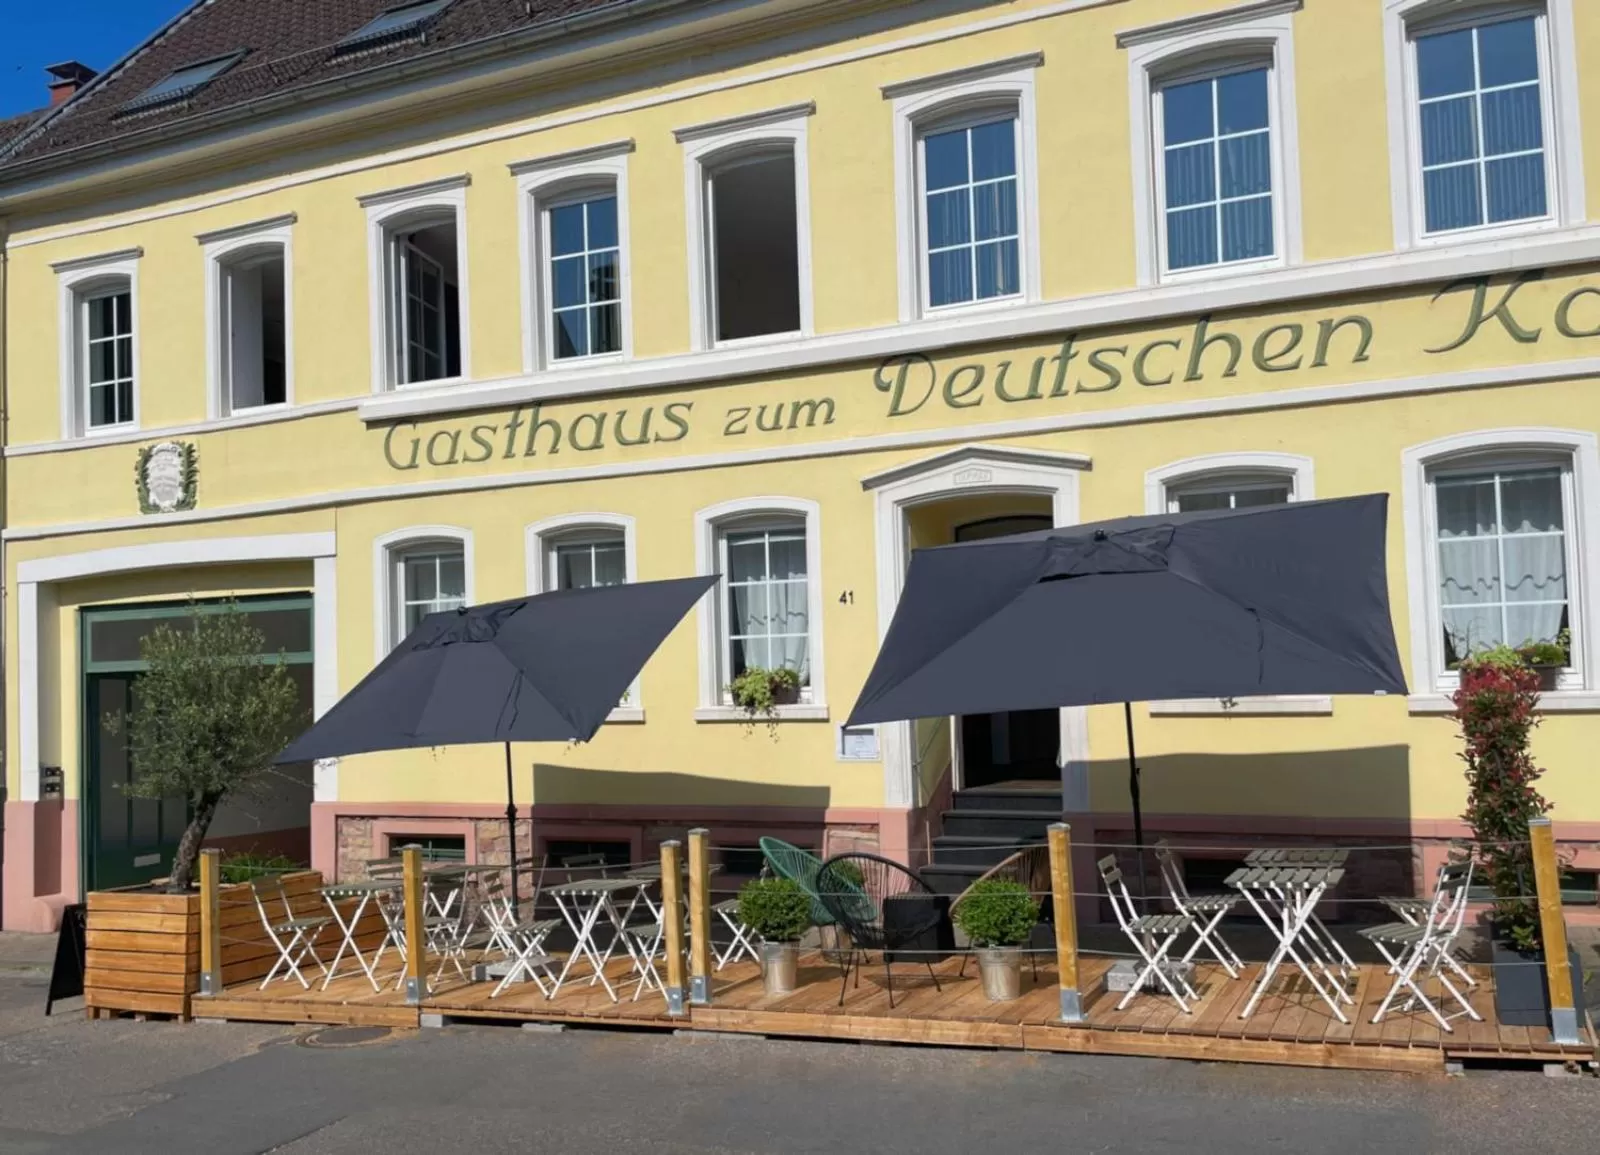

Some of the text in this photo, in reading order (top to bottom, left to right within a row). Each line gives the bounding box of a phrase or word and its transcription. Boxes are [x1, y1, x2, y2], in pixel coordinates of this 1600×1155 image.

[384, 400, 694, 470] Gasthaus
[724, 396, 836, 436] zum
[873, 311, 1373, 417] Deutschen
[839, 590, 854, 605] 41
